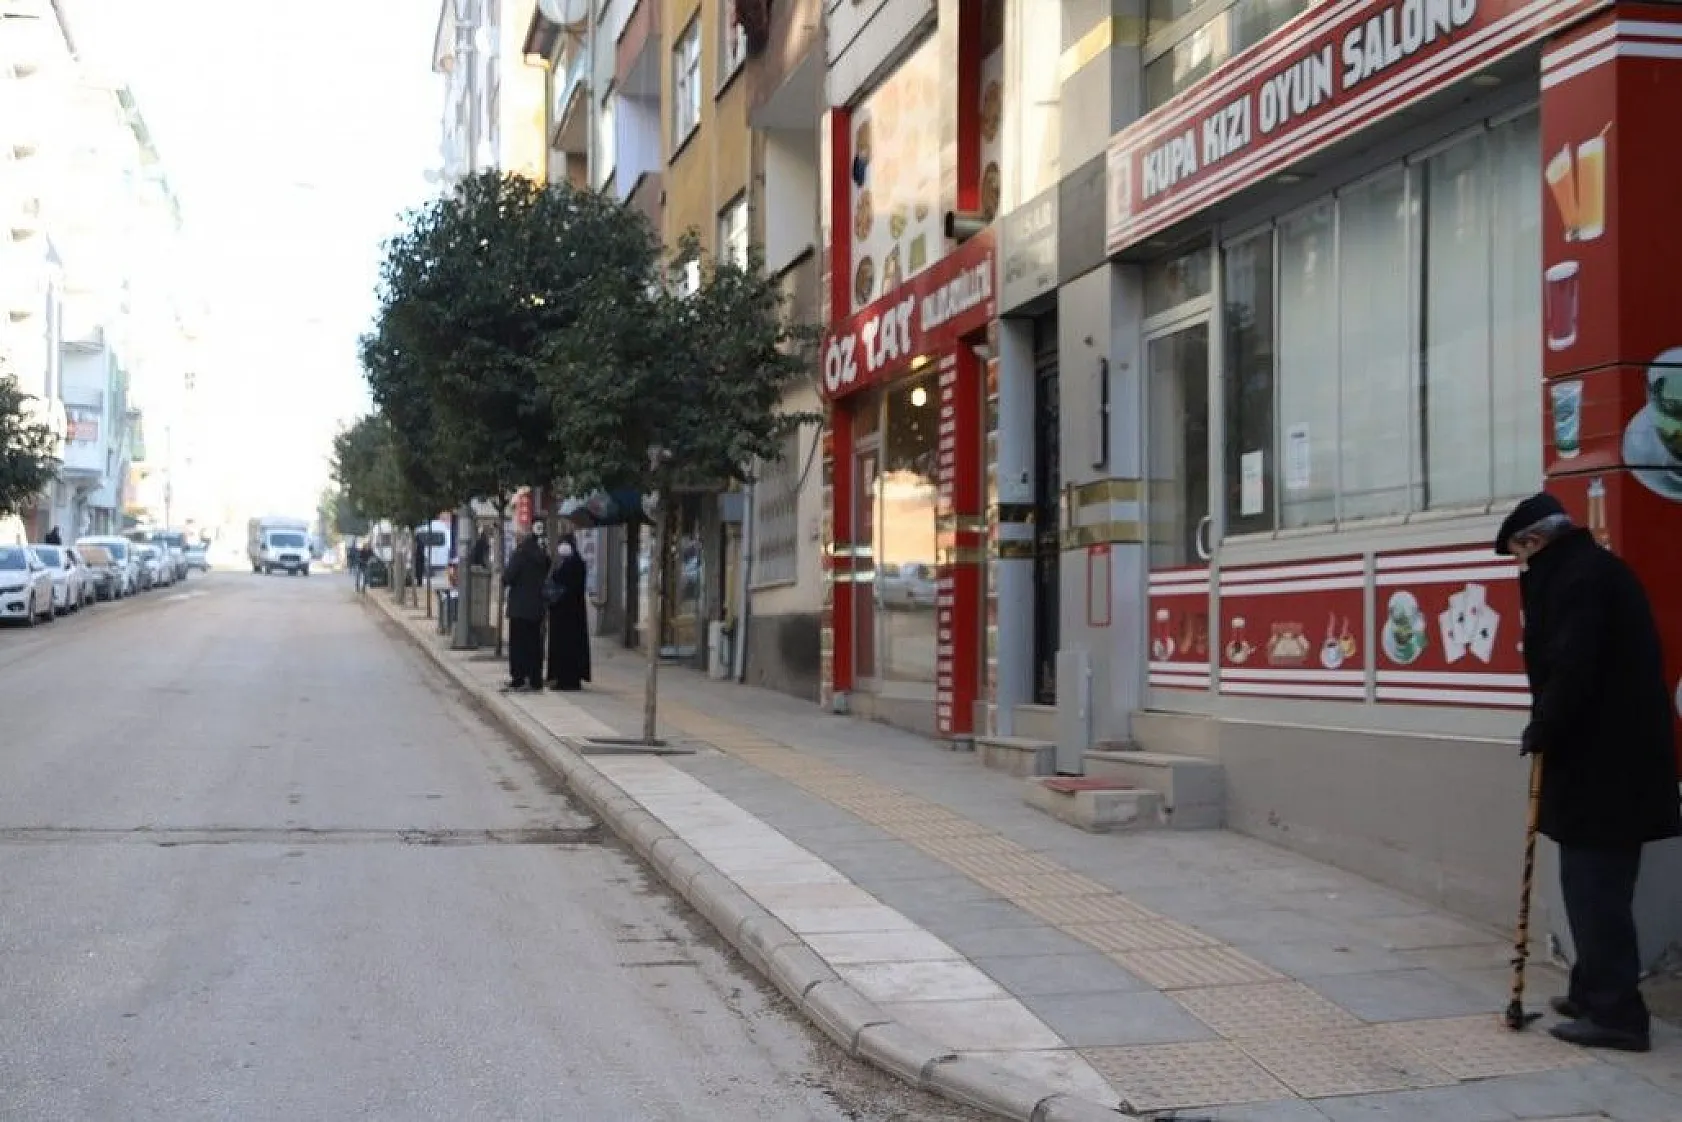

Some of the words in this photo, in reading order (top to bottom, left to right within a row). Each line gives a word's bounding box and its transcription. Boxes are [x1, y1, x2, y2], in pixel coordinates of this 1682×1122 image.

[1142, 127, 1198, 200] KUPA
[1203, 94, 1251, 166] KIZI
[1259, 44, 1333, 134] OYUN
[862, 294, 915, 372] TAT
